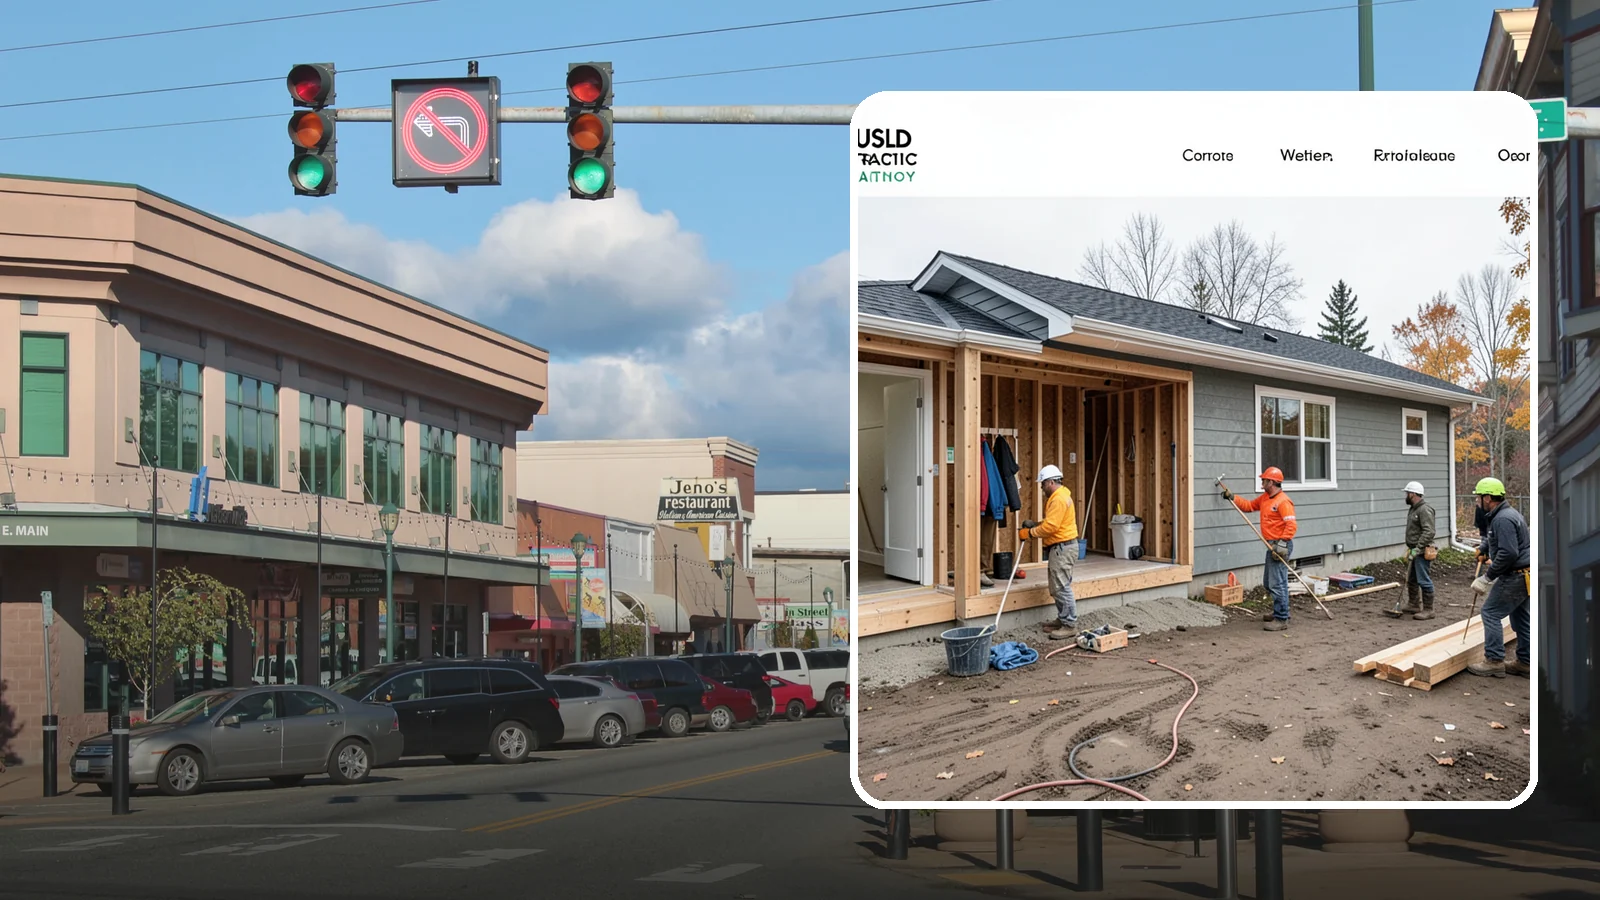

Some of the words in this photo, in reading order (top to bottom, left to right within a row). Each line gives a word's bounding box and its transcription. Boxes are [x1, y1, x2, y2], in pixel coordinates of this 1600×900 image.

[669, 480, 728, 494] Jeno's
[665, 496, 731, 509] restaurant
[658, 509, 682, 520] Italian
[685, 509, 715, 520] American
[714, 509, 738, 520] Cuisine
[2, 525, 13, 536] E.
[15, 525, 49, 537] MAIN
[797, 607, 828, 617] Street
